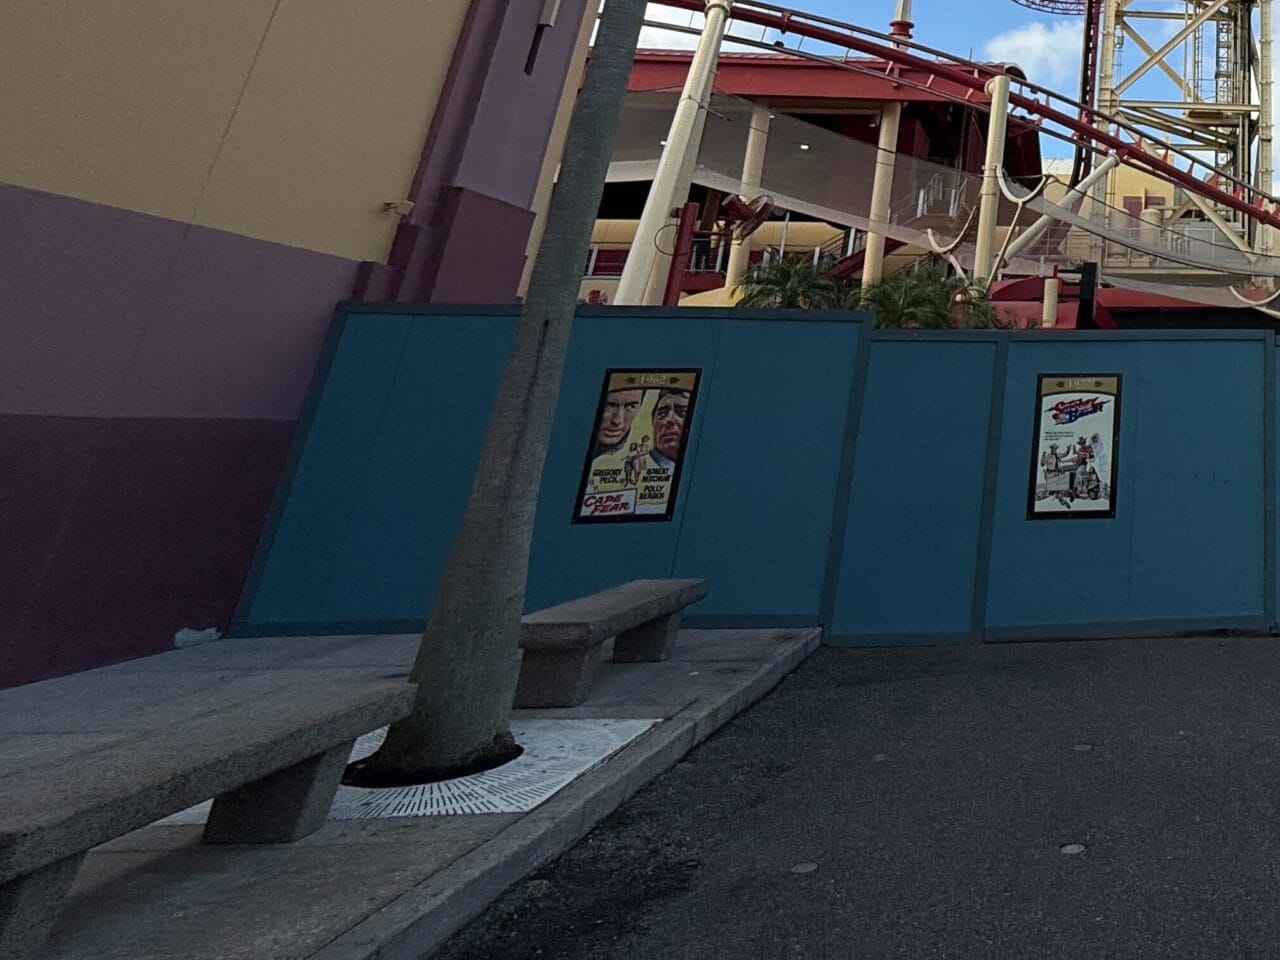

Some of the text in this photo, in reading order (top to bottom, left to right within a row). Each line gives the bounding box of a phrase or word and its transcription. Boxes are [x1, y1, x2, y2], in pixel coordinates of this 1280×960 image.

[640, 375, 665, 384] 1962
[592, 468, 623, 476] GREGORY
[583, 494, 623, 507] CAPE
[590, 502, 630, 515] FEAR
